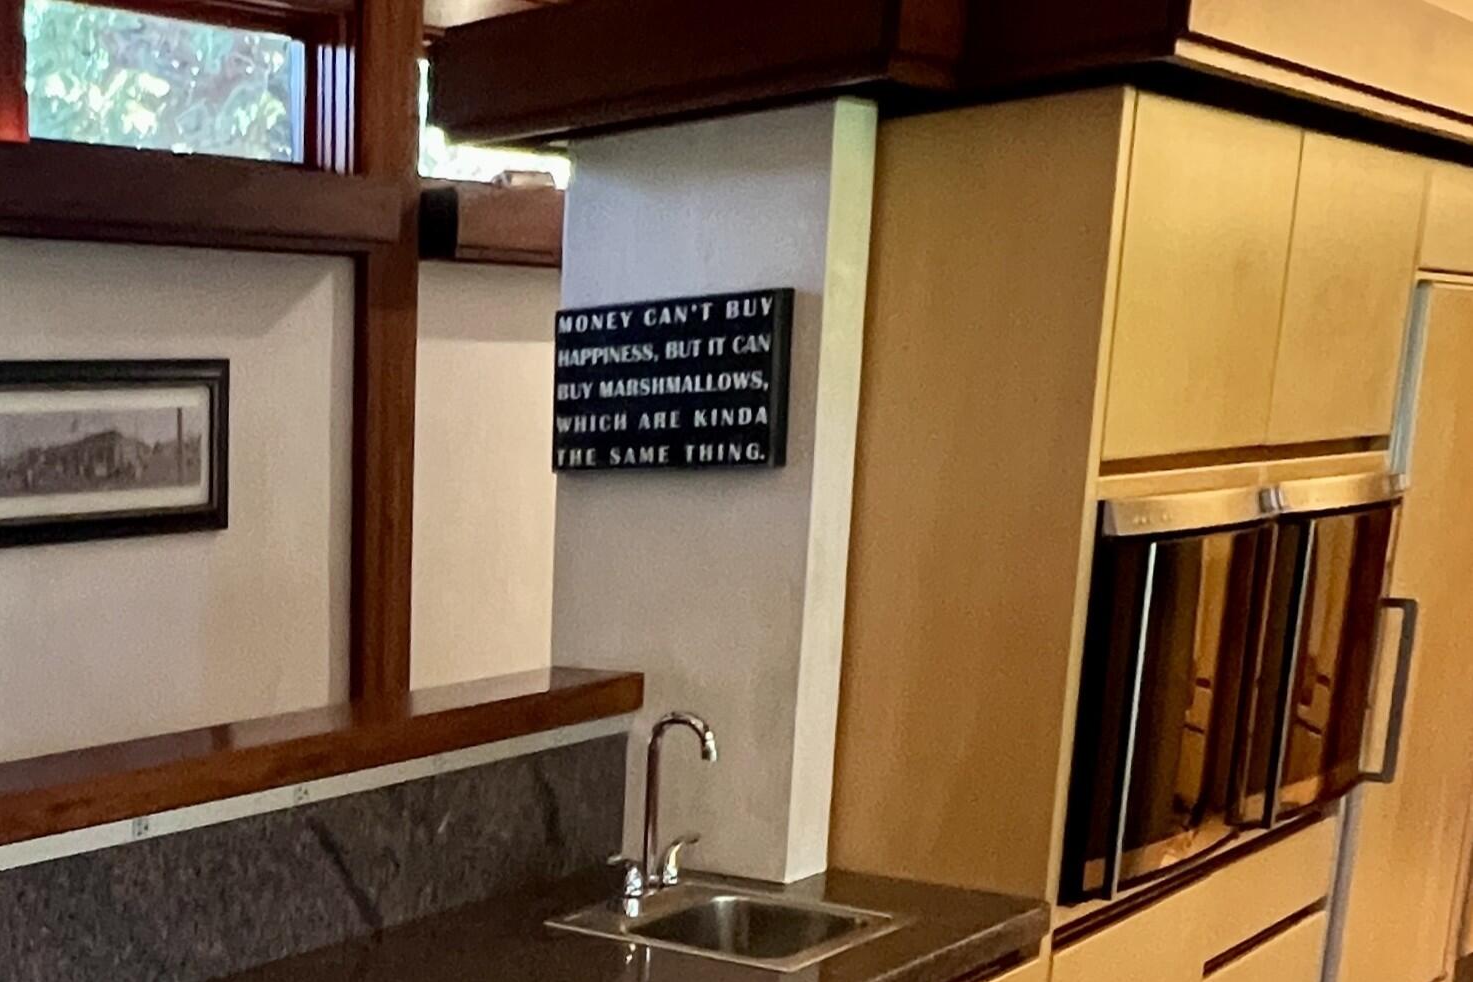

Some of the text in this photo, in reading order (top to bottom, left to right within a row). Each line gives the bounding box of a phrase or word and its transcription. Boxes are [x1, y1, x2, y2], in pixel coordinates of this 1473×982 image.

[558, 296, 773, 334] MONEY CAN'T BUY
[558, 333, 772, 368] HAPPINESS, BUT IT CAN
[557, 370, 769, 400] BUY MARSHMALLOWS,
[556, 406, 768, 433] WHICH ARE KINDA
[557, 442, 766, 467] THE SAME THING.
